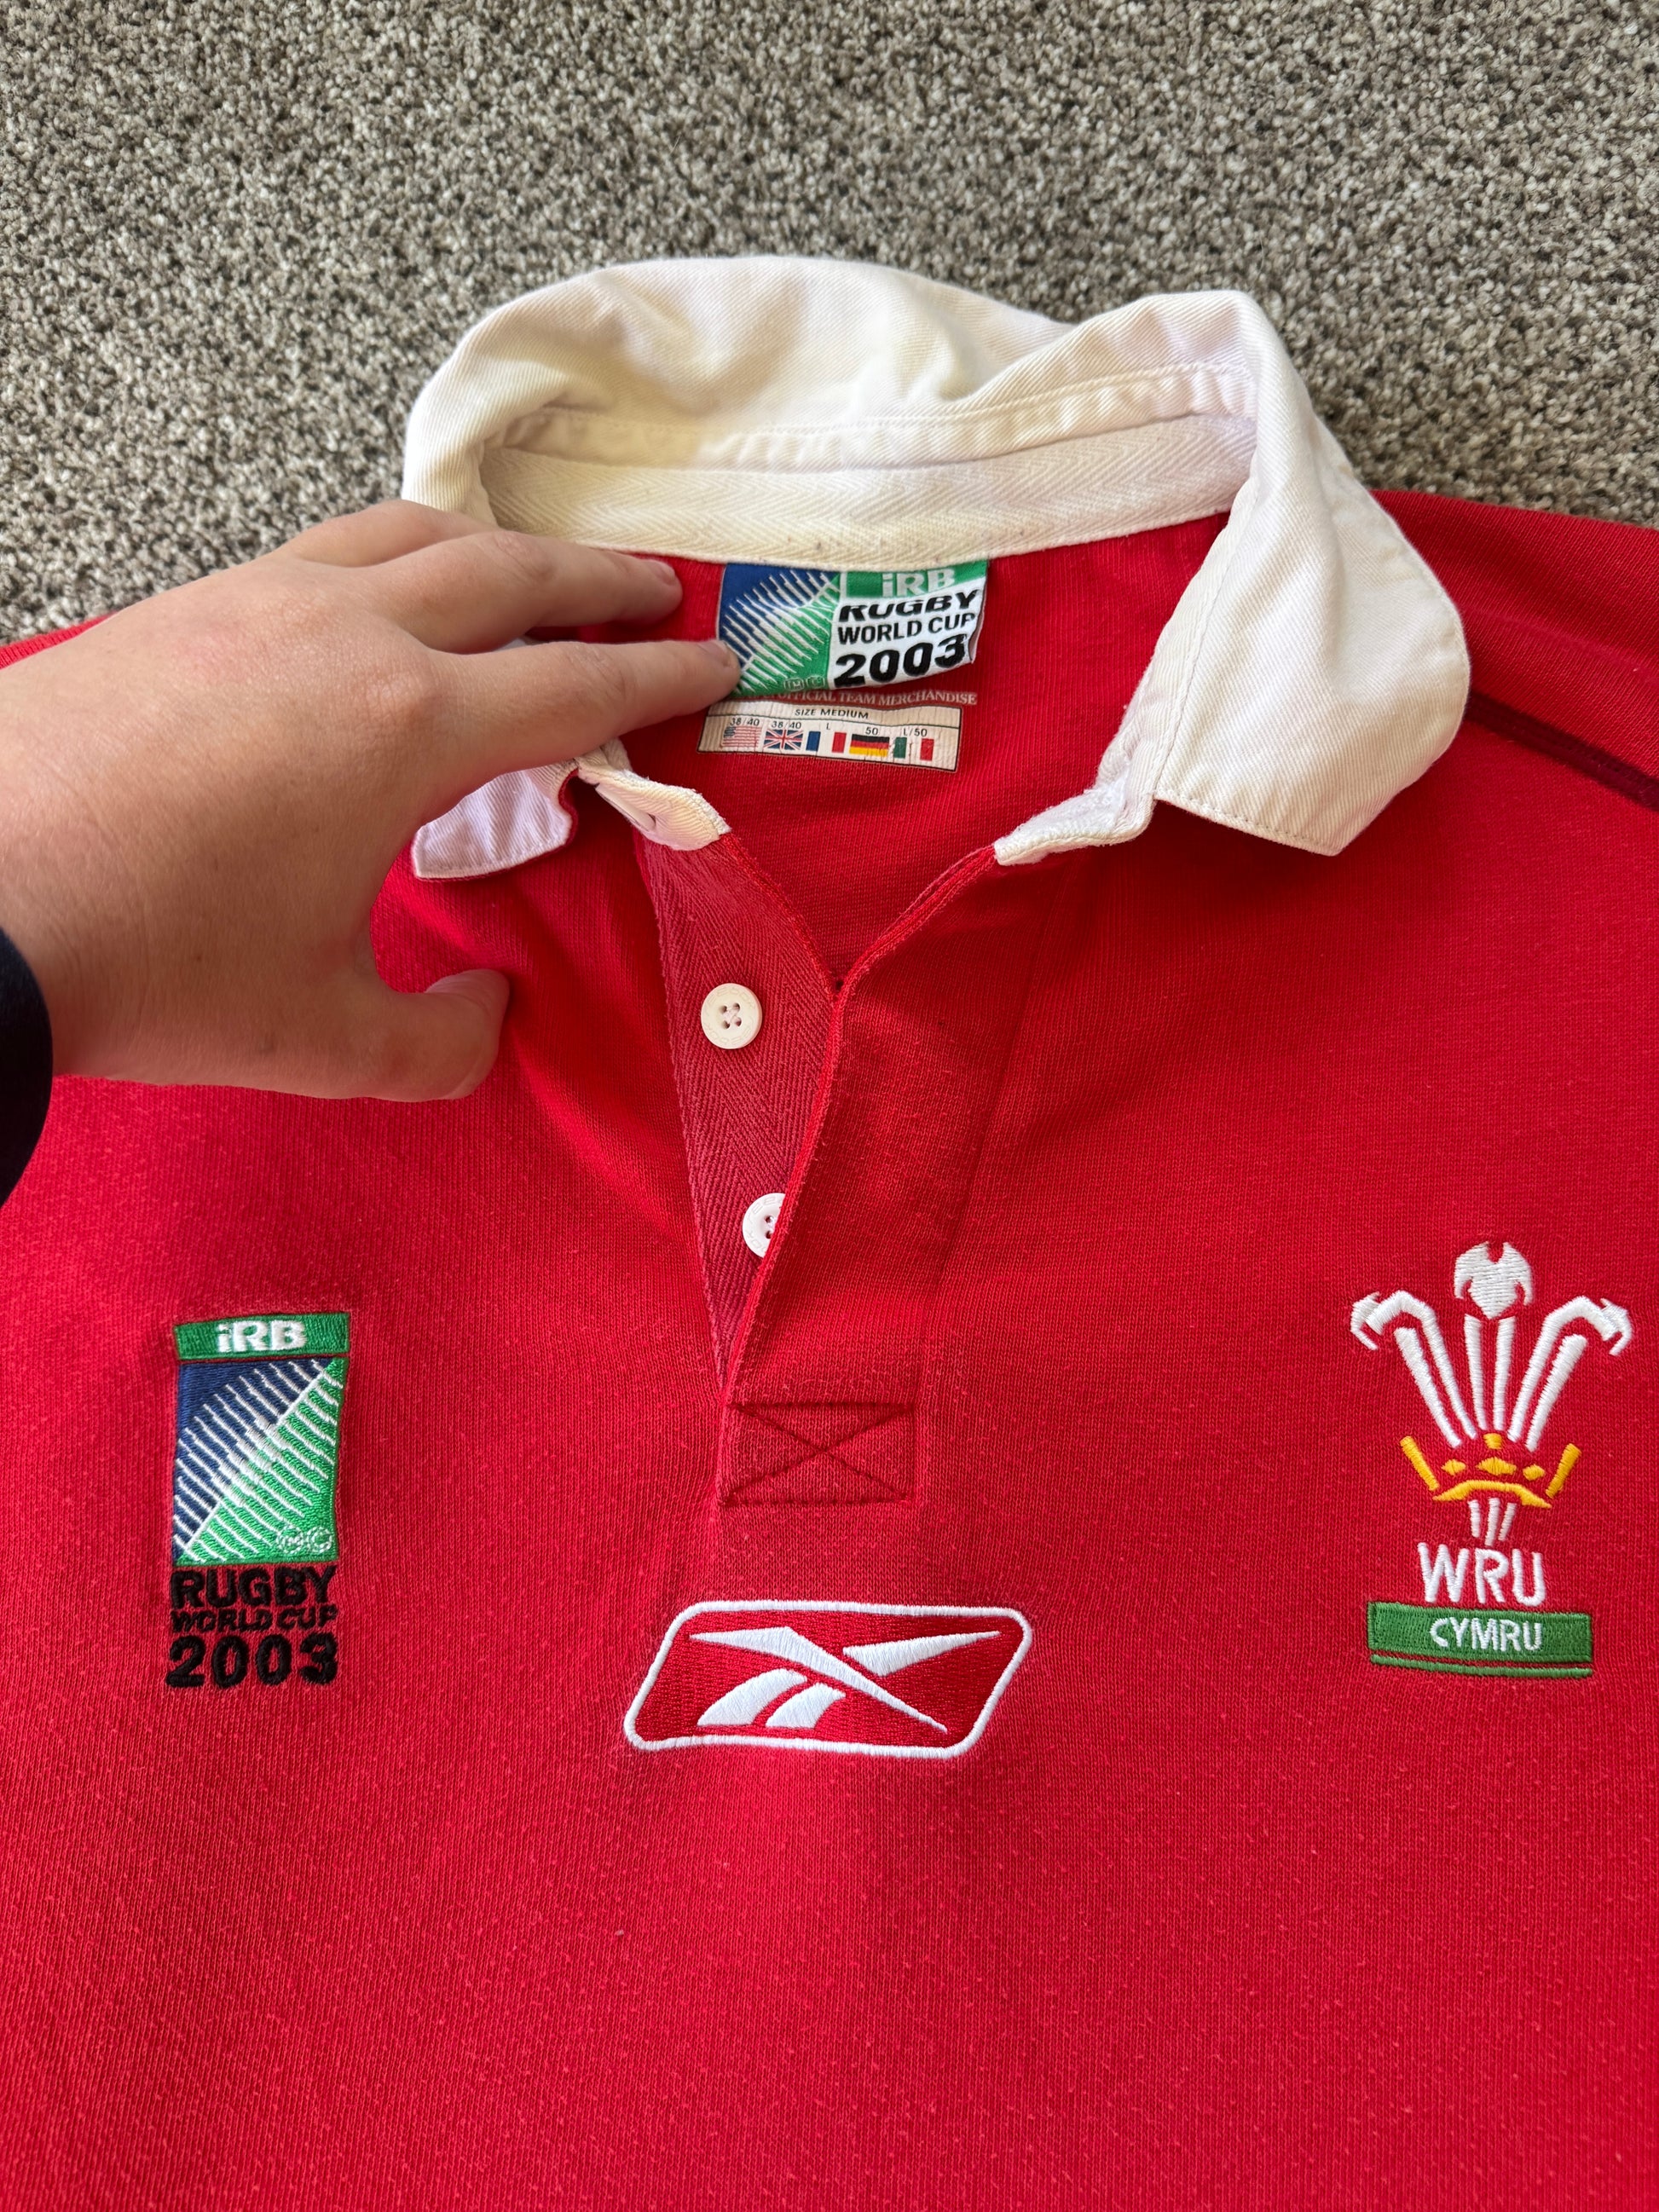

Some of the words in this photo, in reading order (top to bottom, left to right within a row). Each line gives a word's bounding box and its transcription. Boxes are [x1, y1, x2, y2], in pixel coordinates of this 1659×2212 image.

[882, 569, 956, 598] iRB
[838, 589, 980, 622] RUGBY
[837, 620, 922, 644] WORLD
[928, 612, 976, 633] CUP
[833, 633, 968, 688] 2003
[820, 708, 869, 719] MEDIUM
[839, 691, 876, 704] TEAM
[878, 689, 978, 706] MERCHANDISE
[864, 726, 879, 735] 50
[217, 1320, 306, 1354] iRB
[171, 1565, 338, 1609] RUGBY
[1417, 1542, 1546, 1607] WRU
[171, 1608, 274, 1632] WORLD
[277, 1603, 338, 1631] CUP
[1429, 1616, 1543, 1652] CYMRU
[165, 1632, 338, 1689] 2003
